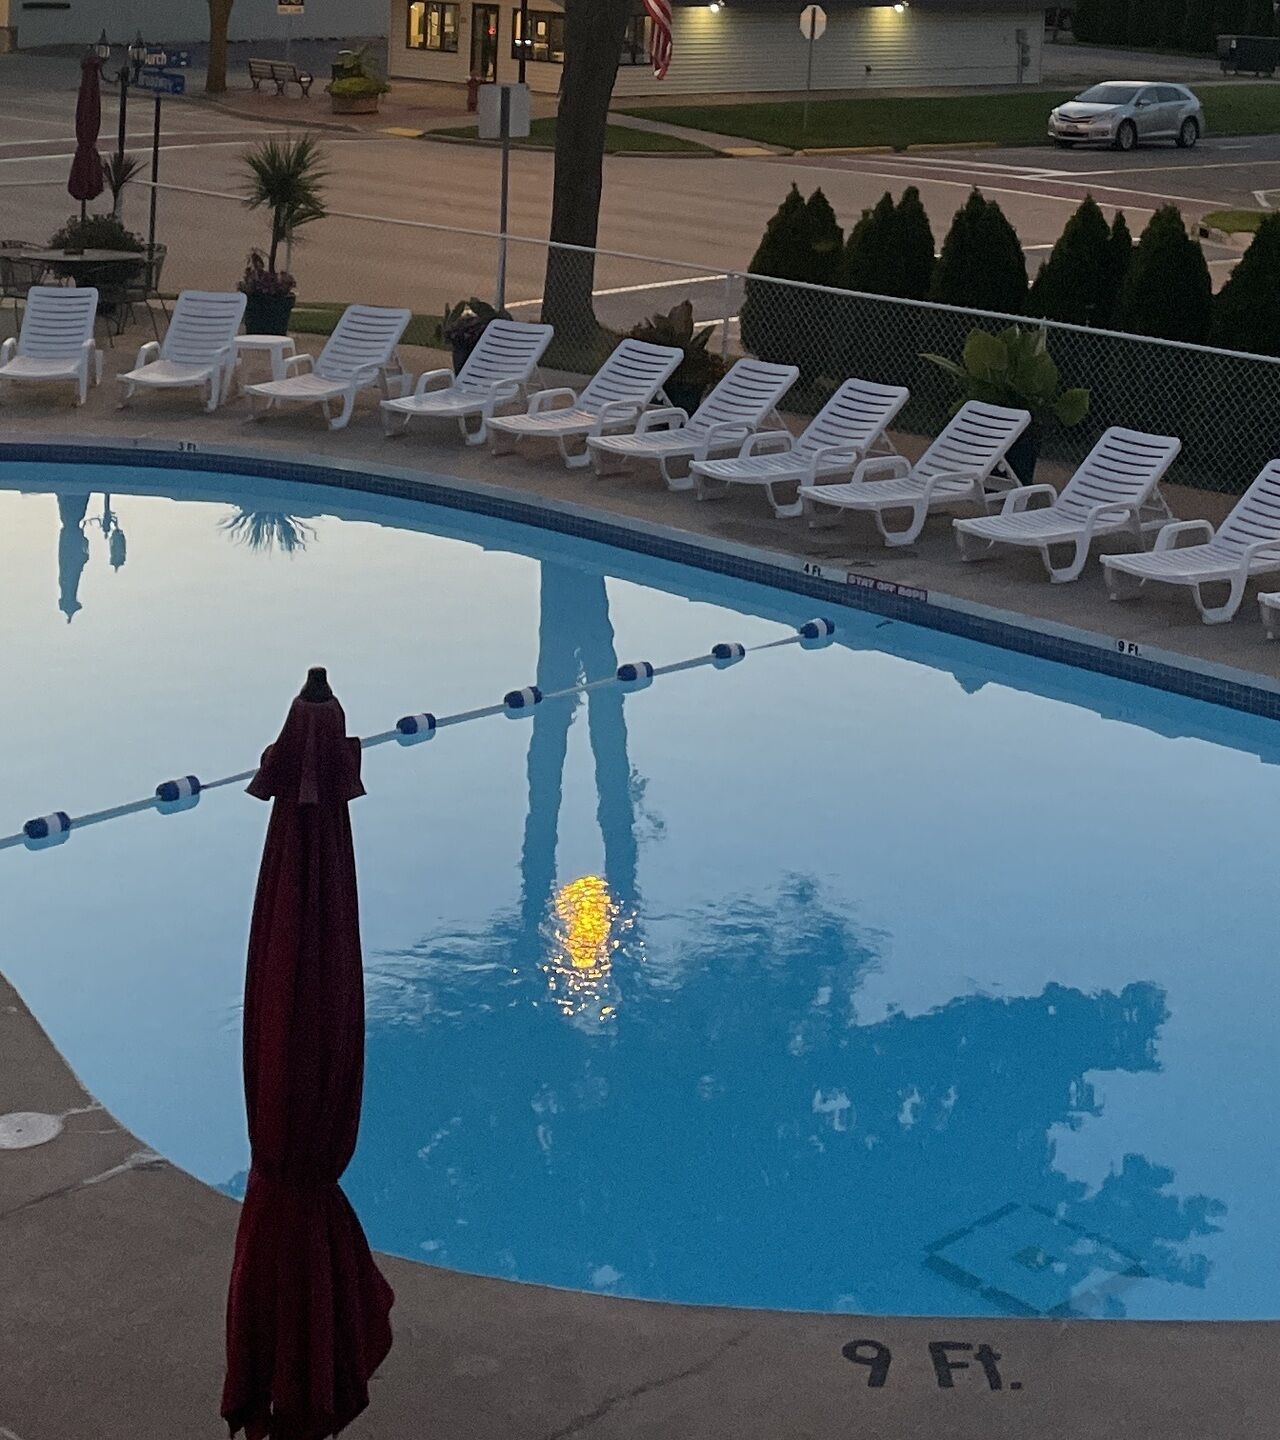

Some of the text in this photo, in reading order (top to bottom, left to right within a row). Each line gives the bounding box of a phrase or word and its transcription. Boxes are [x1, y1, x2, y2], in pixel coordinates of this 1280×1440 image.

[803, 563, 810, 574] 4
[848, 575, 875, 589] STAY
[876, 581, 897, 594] OFF
[1118, 640, 1125, 652] 9
[841, 1339, 1023, 1391] 9 Ft.
